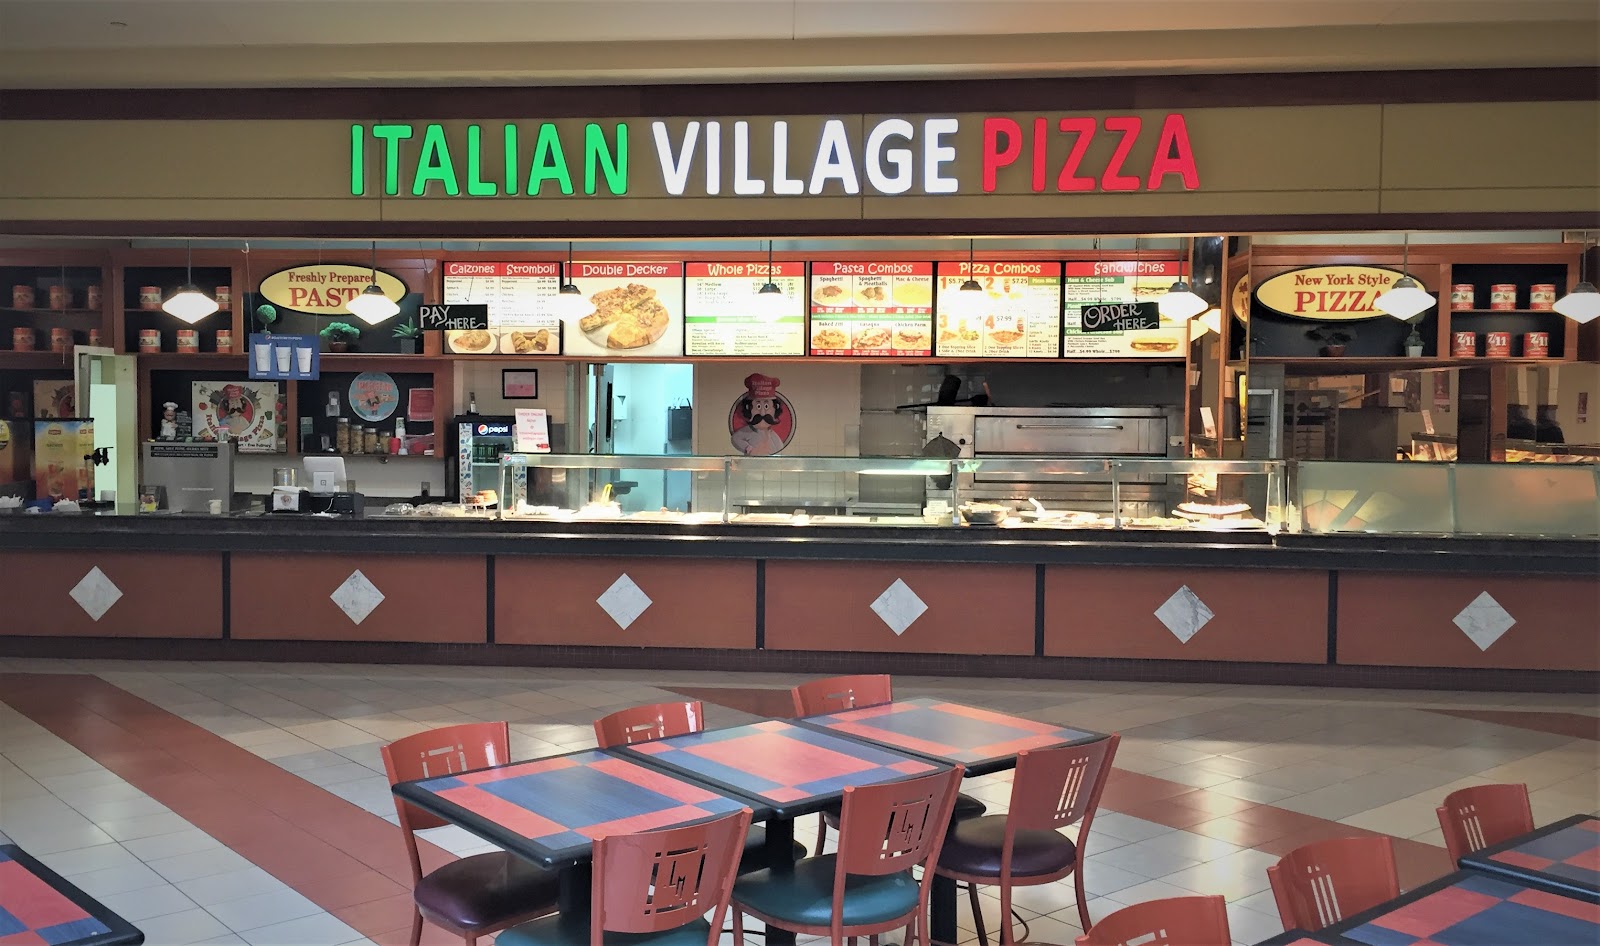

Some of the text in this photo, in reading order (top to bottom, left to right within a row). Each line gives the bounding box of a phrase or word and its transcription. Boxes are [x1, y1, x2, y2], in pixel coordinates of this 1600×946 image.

[350, 112, 1199, 197] ITALIAN VILLAGE PIZZA
[449, 263, 556, 276] Calzones Stromboli
[582, 264, 669, 277] Double Decker
[707, 263, 782, 277] Whole Pizzas
[833, 262, 913, 275] Pasta Combos
[958, 262, 1042, 275] Pizza Combos
[1094, 262, 1166, 275] Sandwiches
[288, 271, 327, 284] Freshly
[940, 276, 947, 290] 1
[985, 276, 995, 290] 2
[1294, 273, 1391, 288] New York Style
[288, 287, 360, 308] PAST
[419, 305, 451, 329] PAY
[985, 314, 995, 329] 4
[1083, 303, 1143, 329] ORDER
[444, 317, 487, 330] HERE
[1113, 317, 1158, 331] HERE
[488, 425, 509, 434] pepsi
